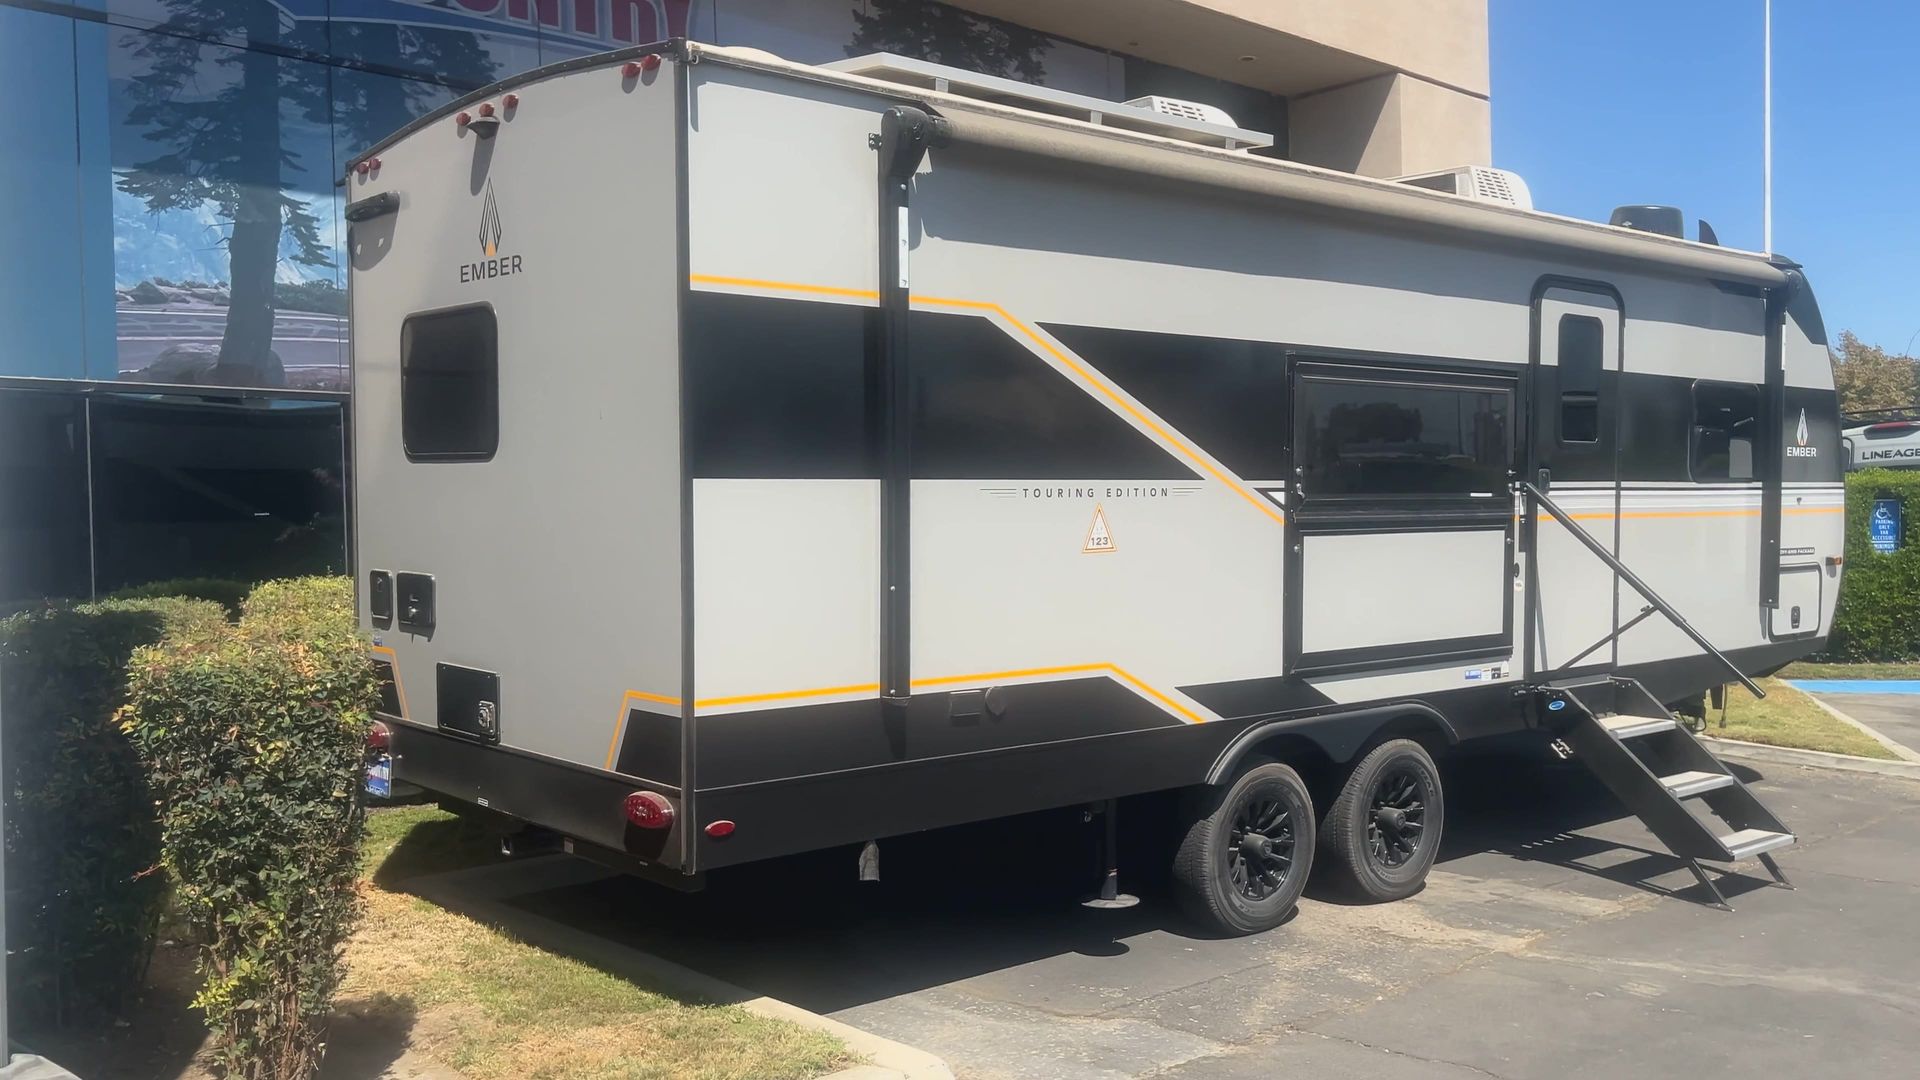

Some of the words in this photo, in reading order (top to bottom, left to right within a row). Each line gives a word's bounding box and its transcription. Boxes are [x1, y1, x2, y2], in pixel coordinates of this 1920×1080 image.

[460, 254, 523, 283] EMBER
[1786, 446, 1817, 457] EMBER
[1022, 488, 1095, 498] TOURING
[1106, 487, 1168, 497] EDITION
[1091, 537, 1109, 546] 123
